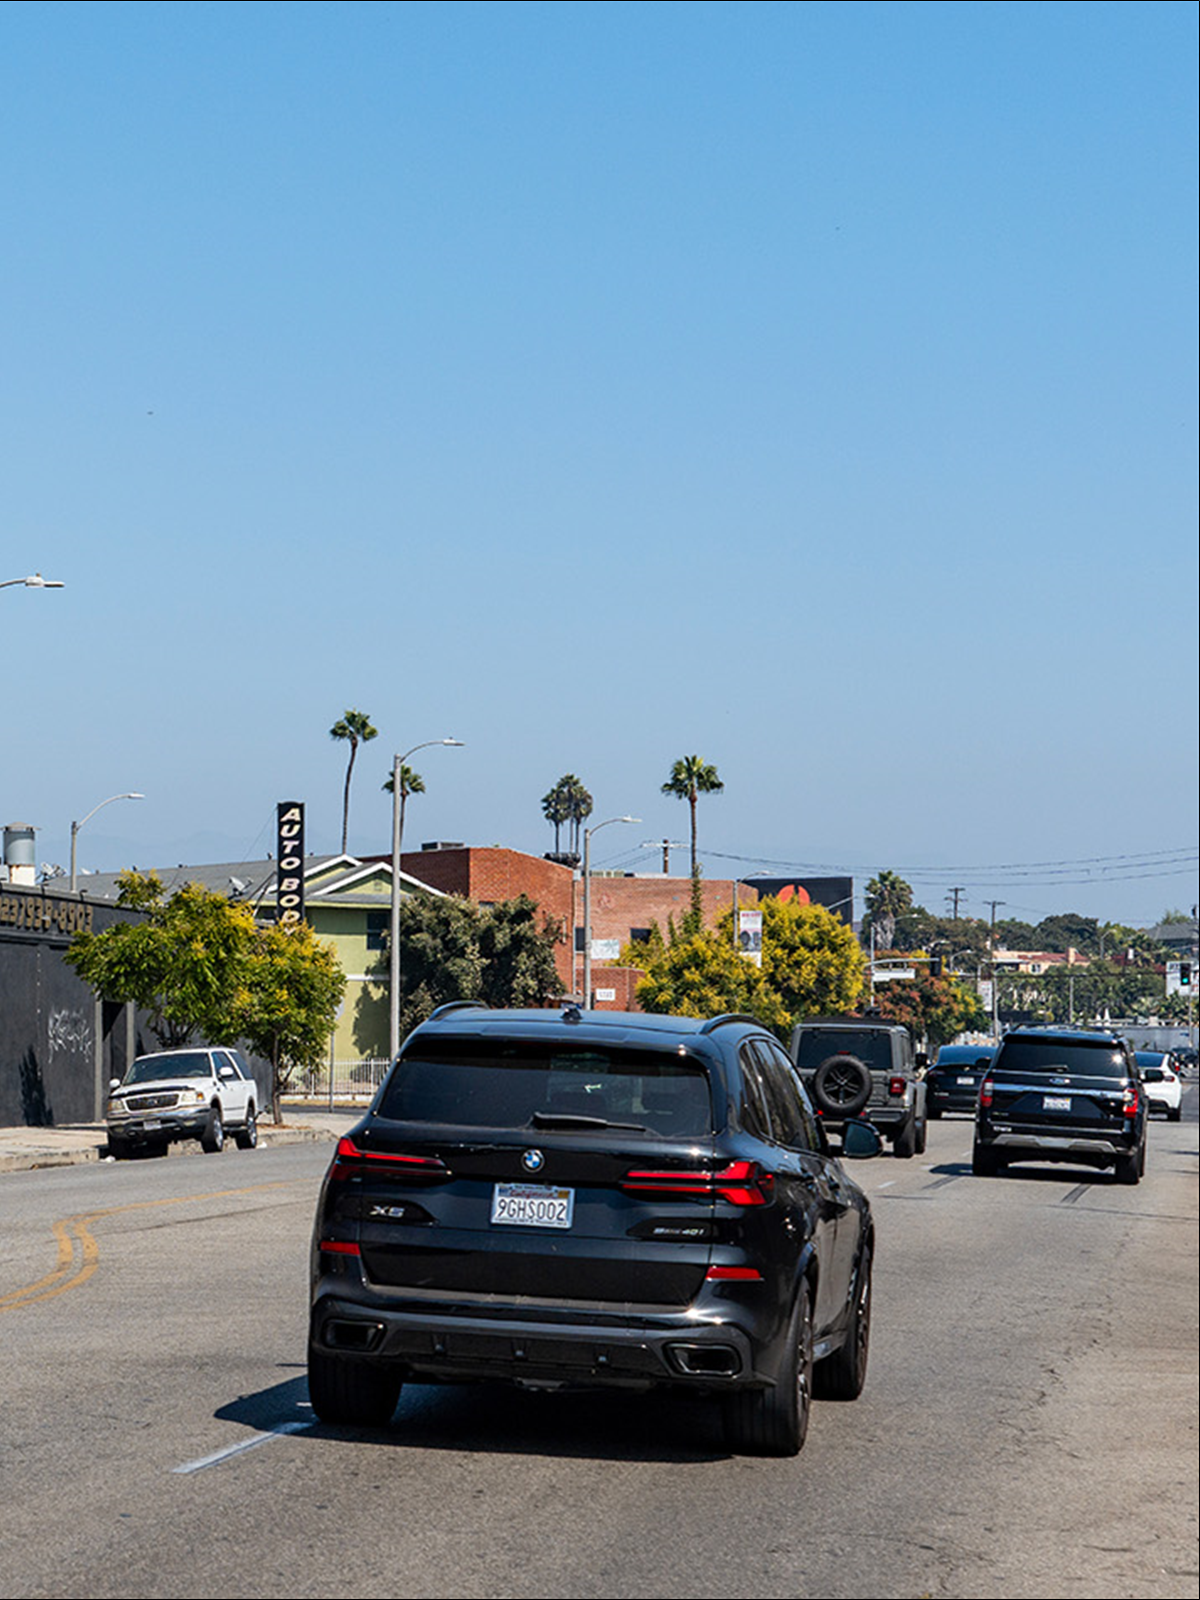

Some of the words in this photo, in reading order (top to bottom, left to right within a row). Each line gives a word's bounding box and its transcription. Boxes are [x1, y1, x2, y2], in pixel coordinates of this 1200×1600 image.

[280, 808, 301, 870] AUTO
[370, 1205, 404, 1217] X5
[498, 1198, 566, 1221] 9GHS002
